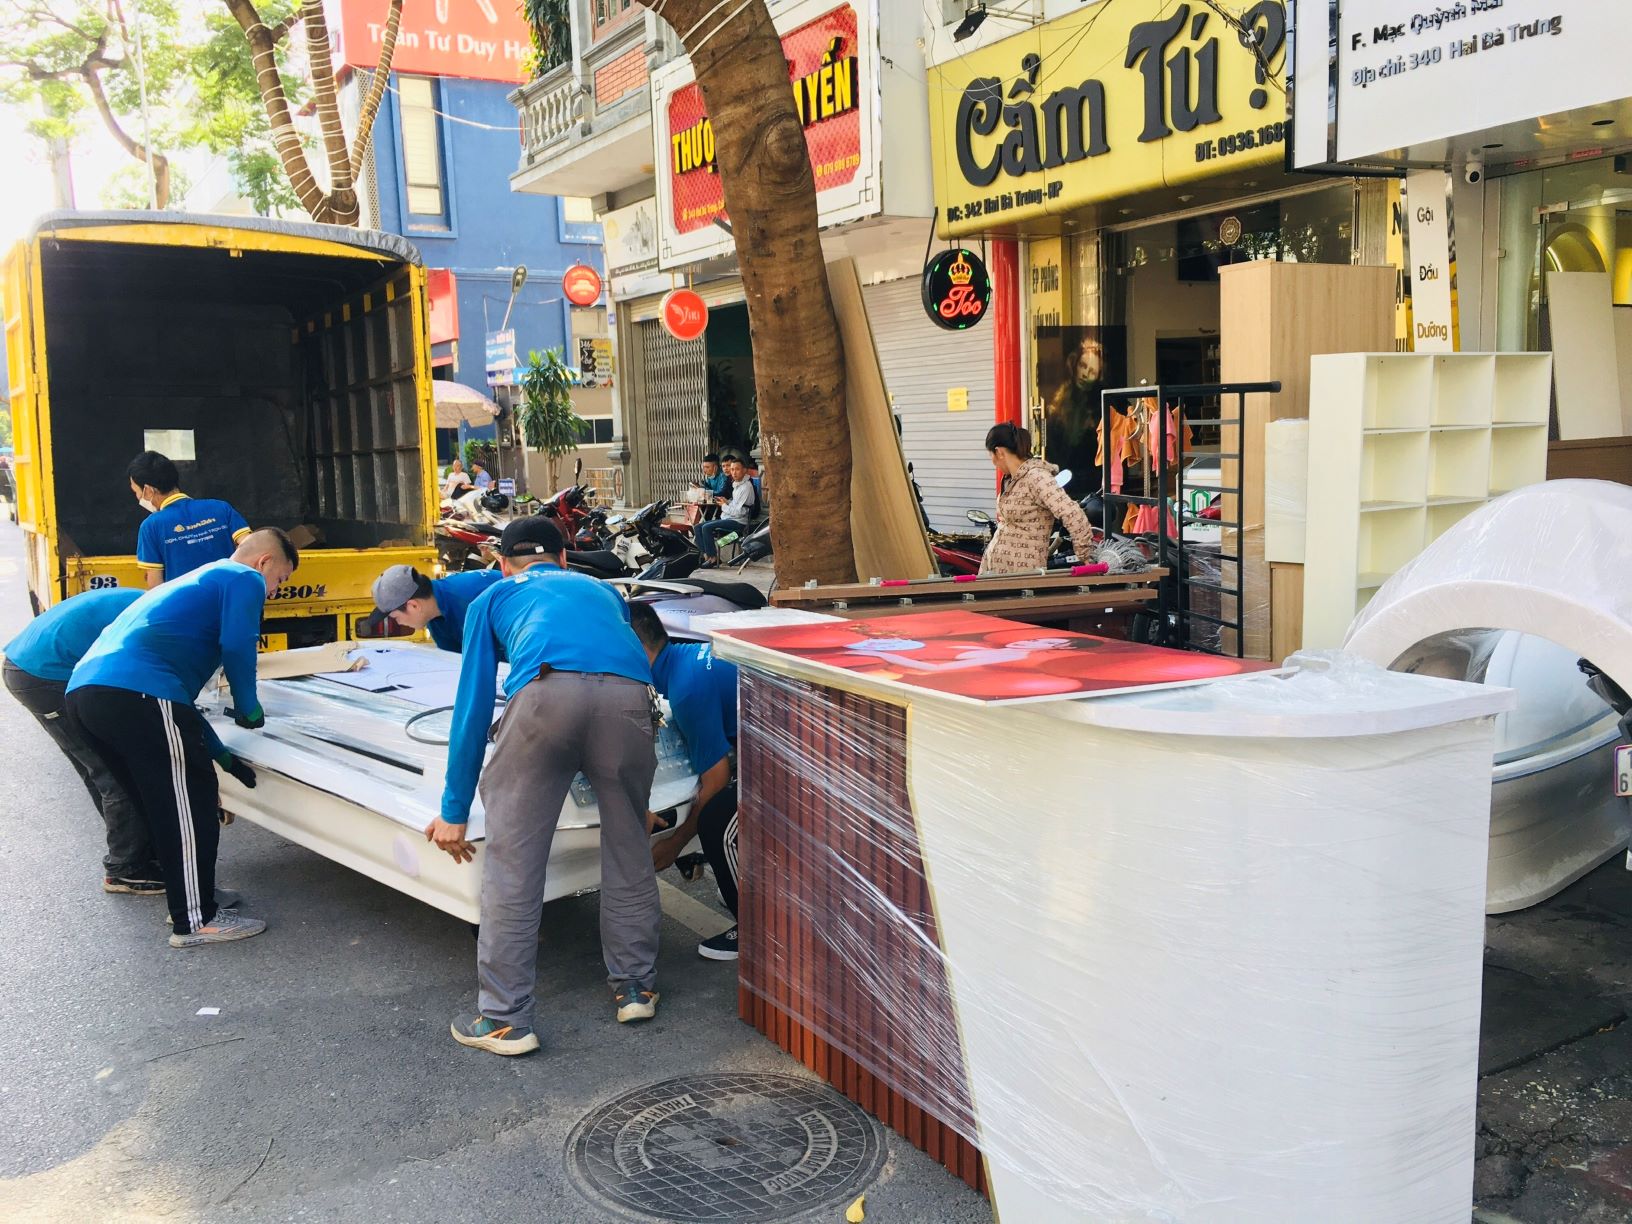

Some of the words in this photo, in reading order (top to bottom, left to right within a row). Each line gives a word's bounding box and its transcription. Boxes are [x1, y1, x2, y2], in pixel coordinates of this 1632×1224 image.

[424, 30, 450, 52] Tư
[457, 34, 497, 62] Duy
[1351, 32, 1367, 50] F.
[1373, 23, 1406, 43] Mạc
[1351, 67, 1376, 88] Địa
[1409, 46, 1442, 70] 340
[1450, 35, 1477, 59] Hai
[1481, 27, 1505, 51] Bà
[1507, 14, 1563, 42] Trưng
[955, 53, 1111, 187] Cẩm
[1124, 3, 1223, 142] Tú
[964, 200, 982, 219] 342
[984, 195, 999, 214] Hai
[1000, 192, 1013, 211] Bà
[1015, 188, 1042, 207] Trưng
[1416, 206, 1434, 226] Gội
[1419, 263, 1438, 281] Đầu
[1417, 321, 1447, 341] Dưỡng
[89, 576, 118, 590] 93
[646, 1096, 693, 1119] THANH
